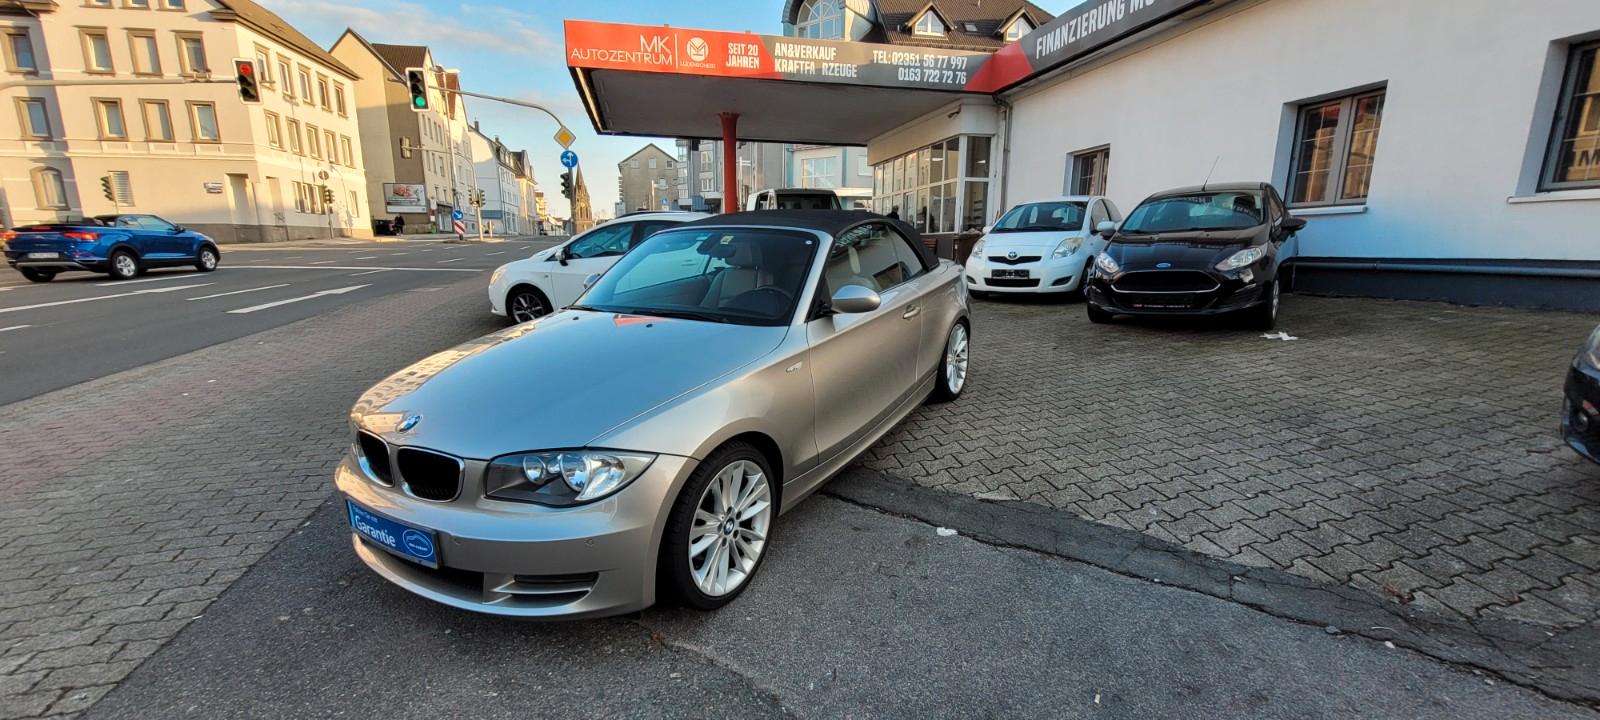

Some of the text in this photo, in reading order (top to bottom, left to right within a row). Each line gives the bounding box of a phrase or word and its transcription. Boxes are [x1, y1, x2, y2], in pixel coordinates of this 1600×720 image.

[1036, 0, 1125, 59] FINANZIERUNG
[640, 34, 671, 54] MK
[728, 42, 759, 57] SEIT 20
[774, 42, 837, 61] AN&VERKAUF
[570, 47, 673, 66] AUTOZENTRUM
[726, 55, 760, 70] JAHREN
[922, 54, 935, 68] 56
[936, 55, 949, 69] 77
[950, 56, 968, 70] 997
[898, 67, 967, 85] 0163 722 72 76
[355, 515, 397, 548] Garantie
